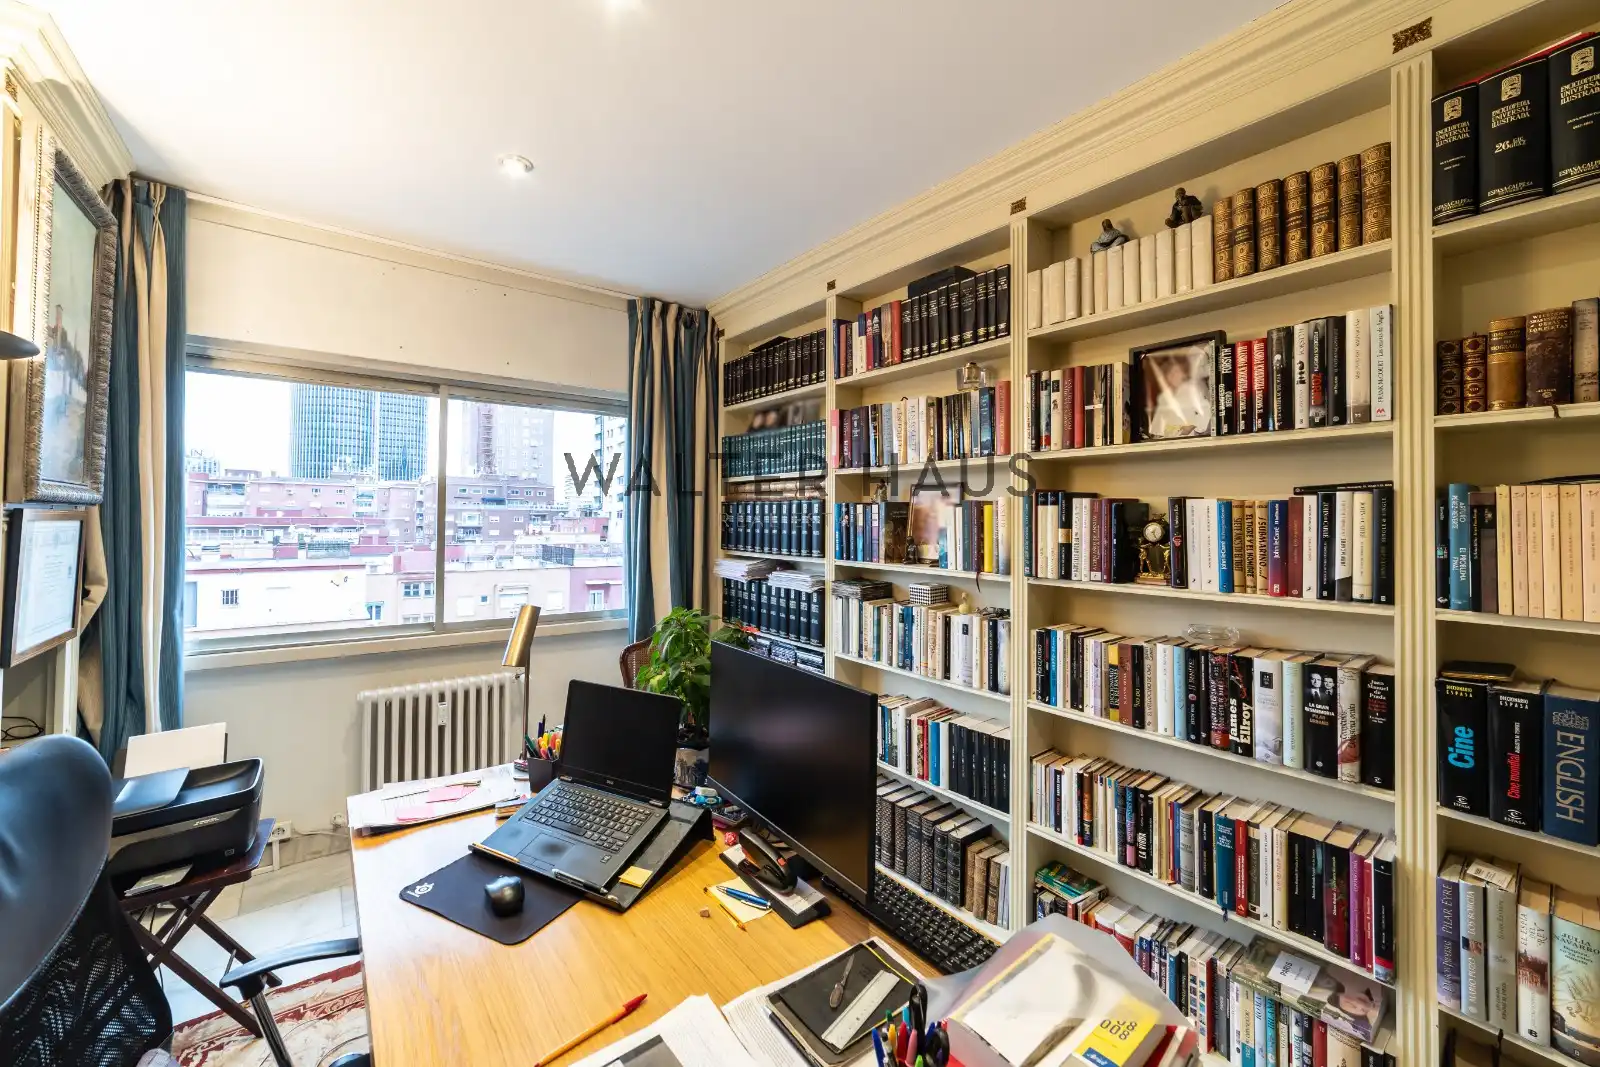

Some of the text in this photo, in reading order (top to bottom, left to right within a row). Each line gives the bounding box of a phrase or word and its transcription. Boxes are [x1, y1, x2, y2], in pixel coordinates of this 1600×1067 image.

[1561, 80, 1600, 98] UNIVERSA
[1561, 87, 1600, 105] ILUSTRAD
[1492, 106, 1530, 122] UNIVERSAL
[1492, 112, 1530, 128] ILUSTRADA
[1436, 127, 1470, 142] UNIVERSAL
[1436, 133, 1470, 148] ILUSTRADA
[1494, 142, 1510, 154] 26
[1222, 348, 1232, 374] FORSYTH
[1459, 502, 1467, 522] ARTURO
[1446, 685, 1472, 693] DICCIONARIO
[1446, 690, 1472, 698] ESPASA
[1500, 695, 1529, 704] DICCIONARIO
[1500, 701, 1529, 710] ESPASA
[1230, 698, 1239, 743] James
[1240, 702, 1253, 745] Ellroy
[1448, 726, 1475, 769] Cine
[1507, 752, 1520, 799] Cine mundial
[1555, 730, 1585, 824] ENGLISH
[1504, 817, 1526, 825] ESPASA
[1442, 884, 1453, 934] PILAR EYRE
[1468, 921, 1476, 935] LOS
[1561, 933, 1591, 947] JULIA
[1280, 962, 1293, 977] PARIS
[1468, 957, 1476, 978] PUZO
[1267, 998, 1275, 1030] IRLAND
[1100, 1020, 1130, 1040] 008
[1294, 1034, 1302, 1062] BERLIN
